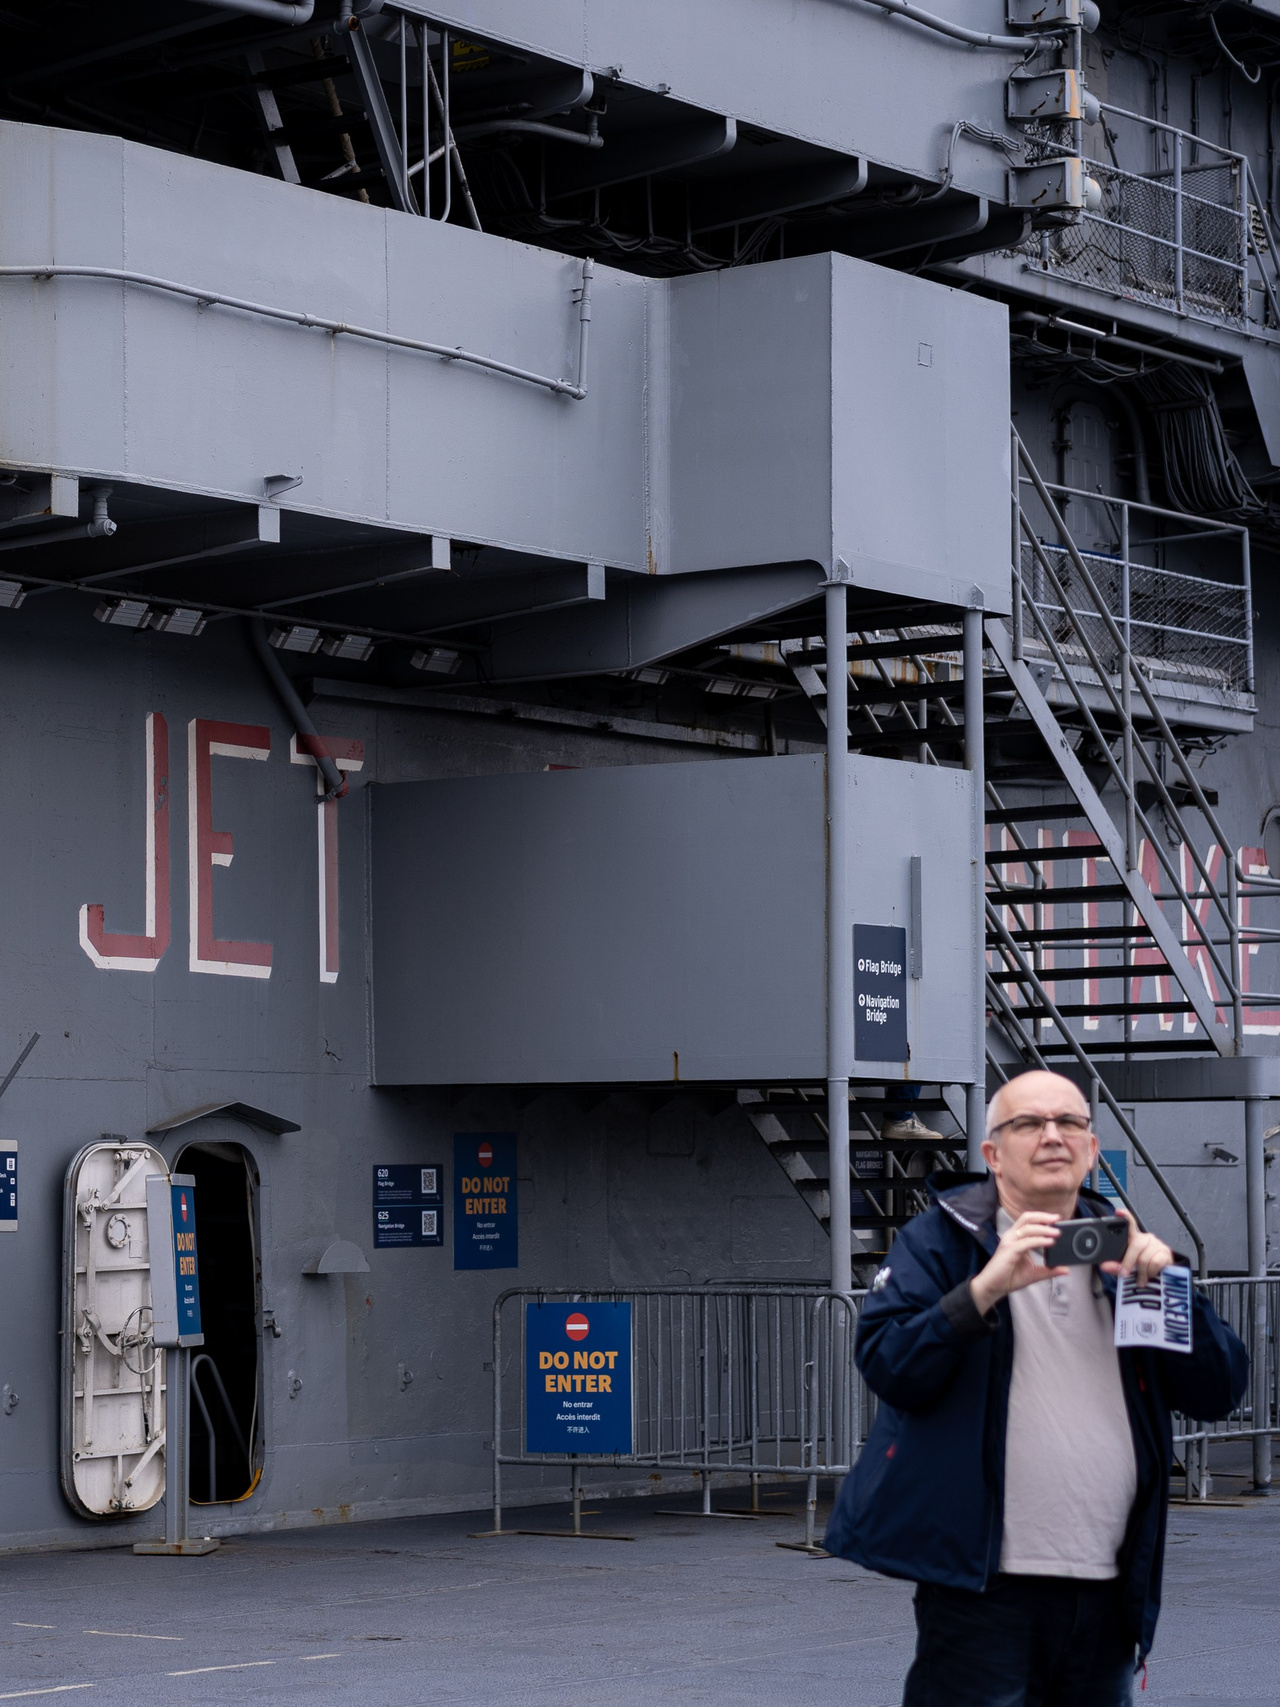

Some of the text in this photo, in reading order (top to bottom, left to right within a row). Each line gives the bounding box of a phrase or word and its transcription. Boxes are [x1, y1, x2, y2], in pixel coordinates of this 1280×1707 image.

[79, 711, 365, 984] JET
[984, 824, 1280, 1036] NTAKE
[865, 959, 902, 977] Flag Bridge
[866, 994, 900, 1010] Navigation
[866, 1009, 887, 1025] Bridge
[377, 1168, 389, 1178] 620
[855, 1160, 884, 1169] FLAG BRIDGES
[461, 1176, 510, 1194] DO NOT
[465, 1197, 507, 1215] ENTER
[377, 1211, 389, 1220] 625
[176, 1232, 195, 1251] DO NOT
[179, 1256, 196, 1275] ENTER
[1162, 1271, 1190, 1345] MUSEUM
[539, 1351, 618, 1370] DO NOT
[545, 1374, 612, 1393] ENTER
[556, 1413, 601, 1421] Accès interdit
[566, 1426, 590, 1434] 不许进入
